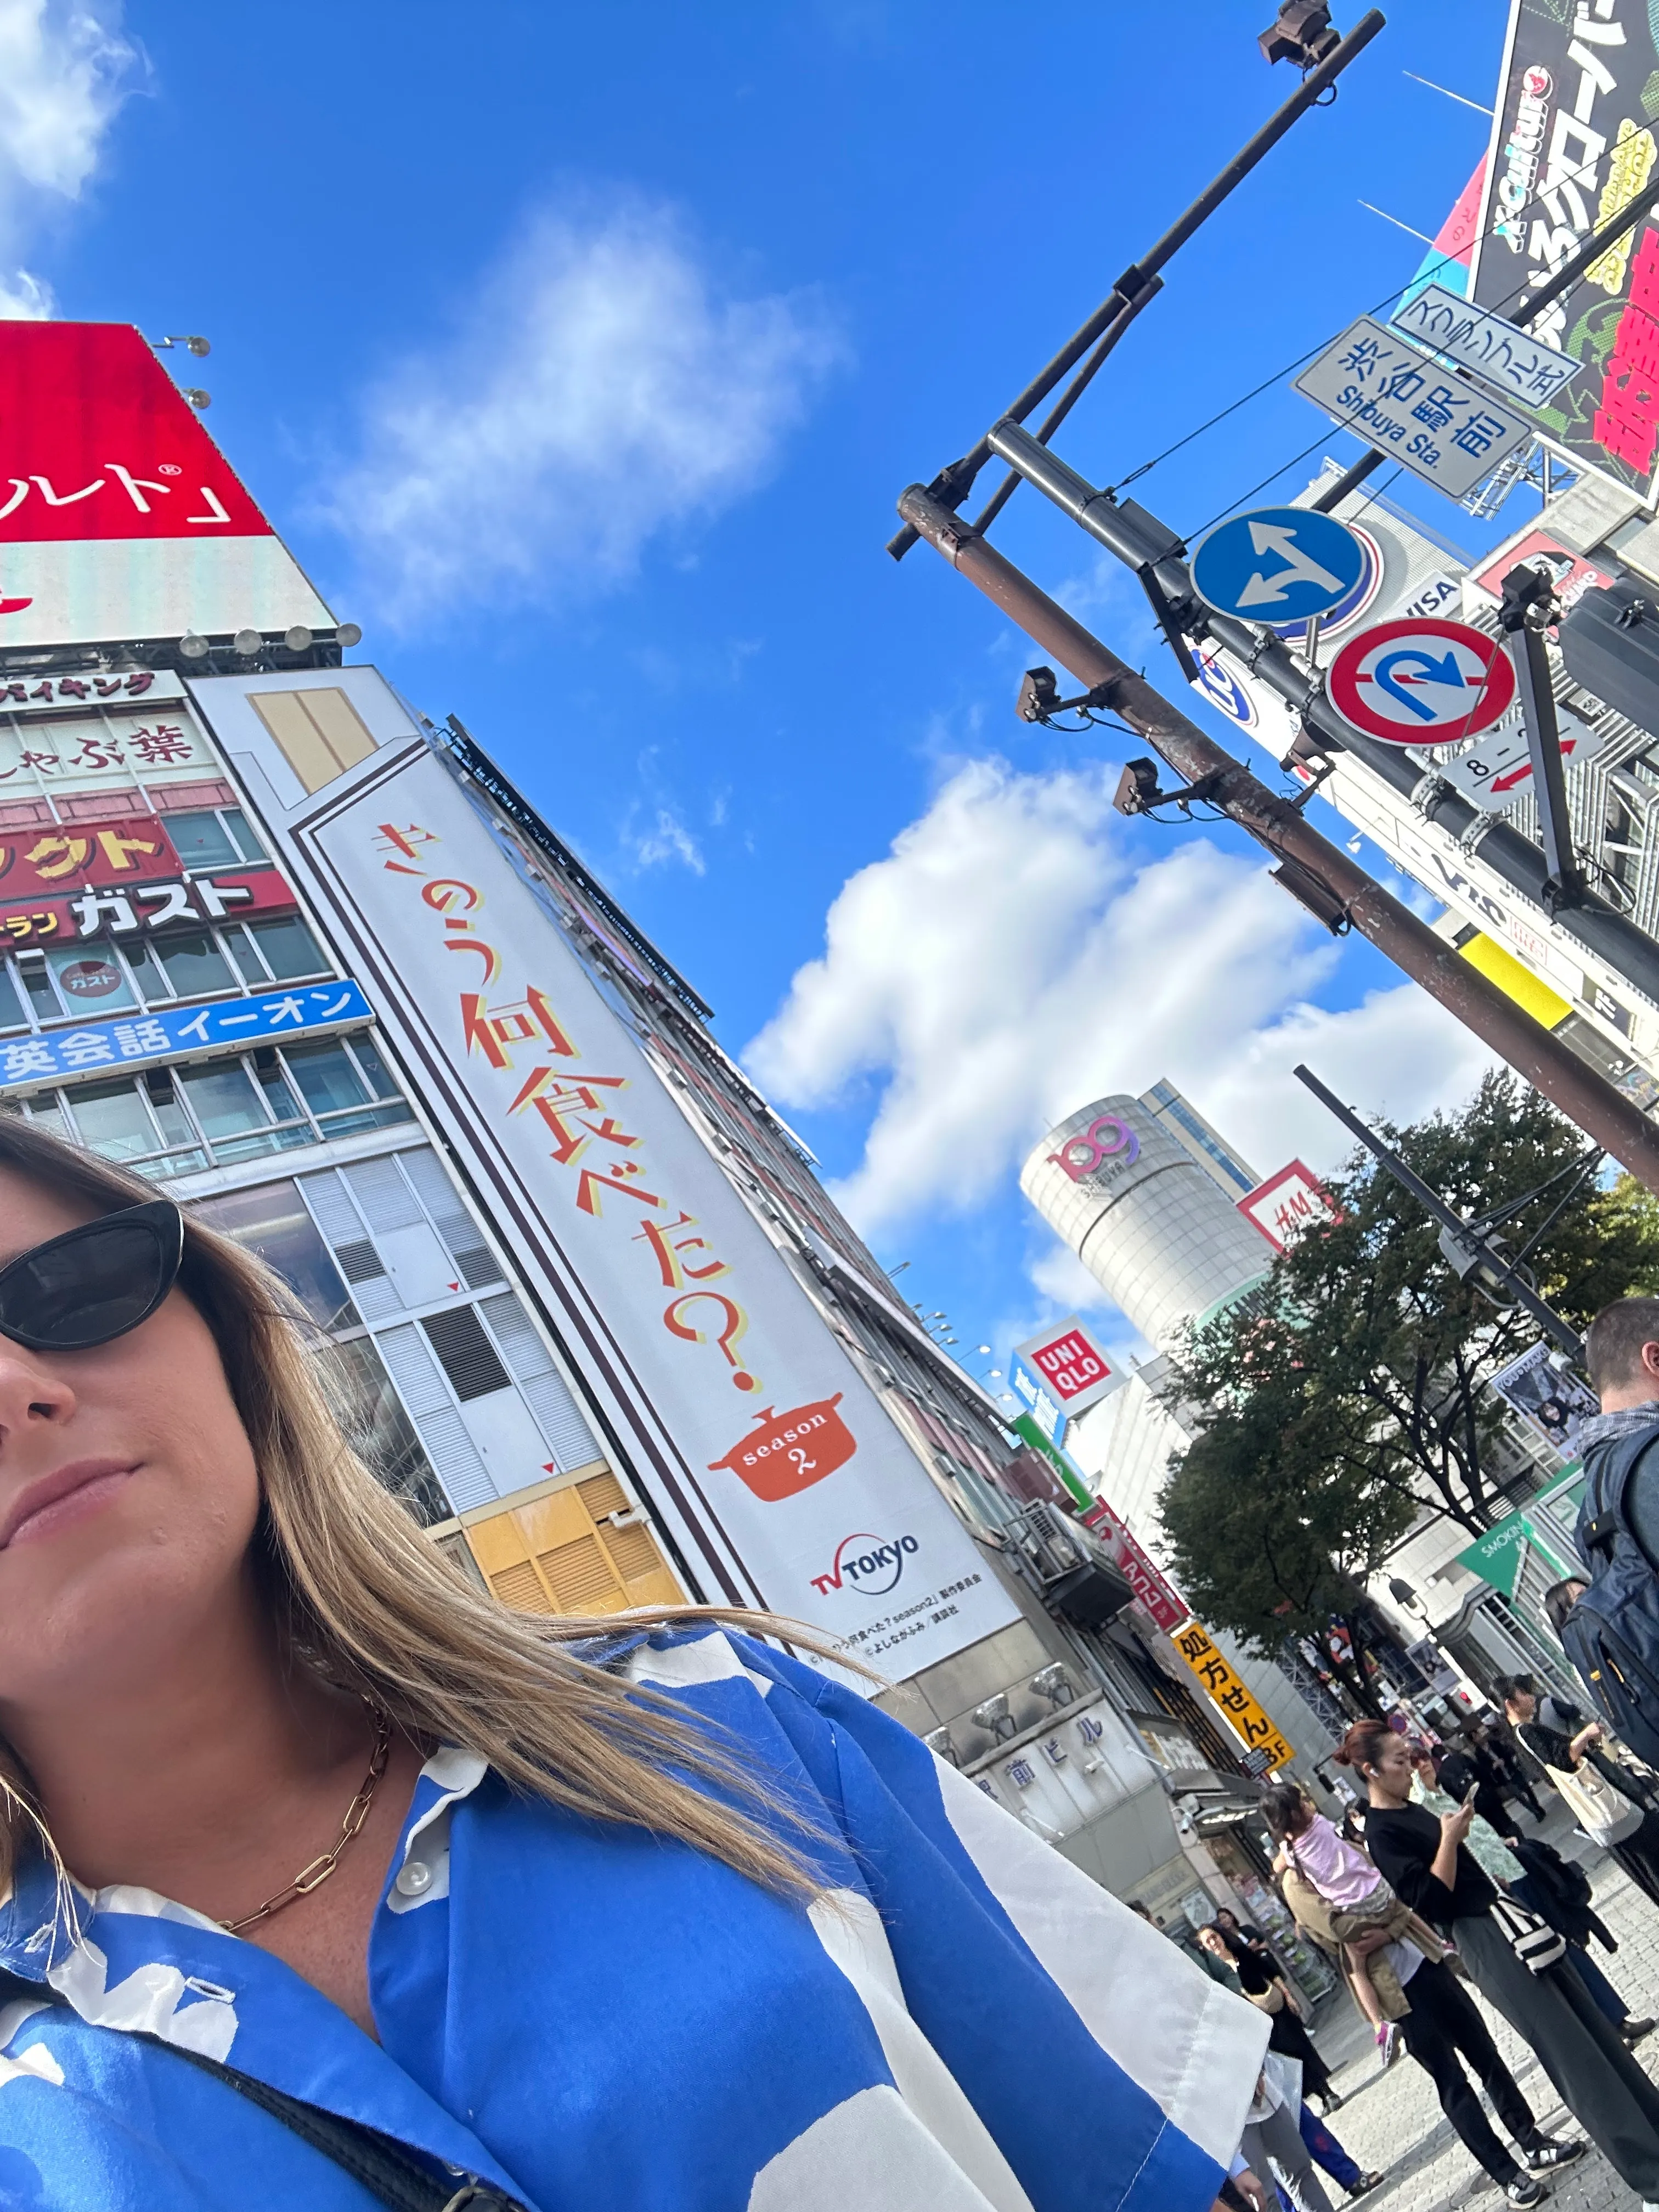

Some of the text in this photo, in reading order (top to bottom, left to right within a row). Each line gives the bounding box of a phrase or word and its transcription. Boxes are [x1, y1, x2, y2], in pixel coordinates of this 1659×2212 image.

[1338, 337, 1506, 459] 渋谷駅前
[1336, 385, 1441, 469] Shibuya Sta.
[72, 879, 252, 937] ガスト
[70, 974, 116, 990] ガスト
[1594, 989, 1617, 1020] 7F
[3, 991, 352, 1080] 英会話イーオン
[1046, 1115, 1141, 1184] 109
[1040, 1339, 1085, 1372] UNI
[1056, 1357, 1101, 1391] QLO
[742, 1413, 828, 1466] season
[788, 1448, 816, 1475] 2
[1180, 1630, 1271, 1743] 処方せん
